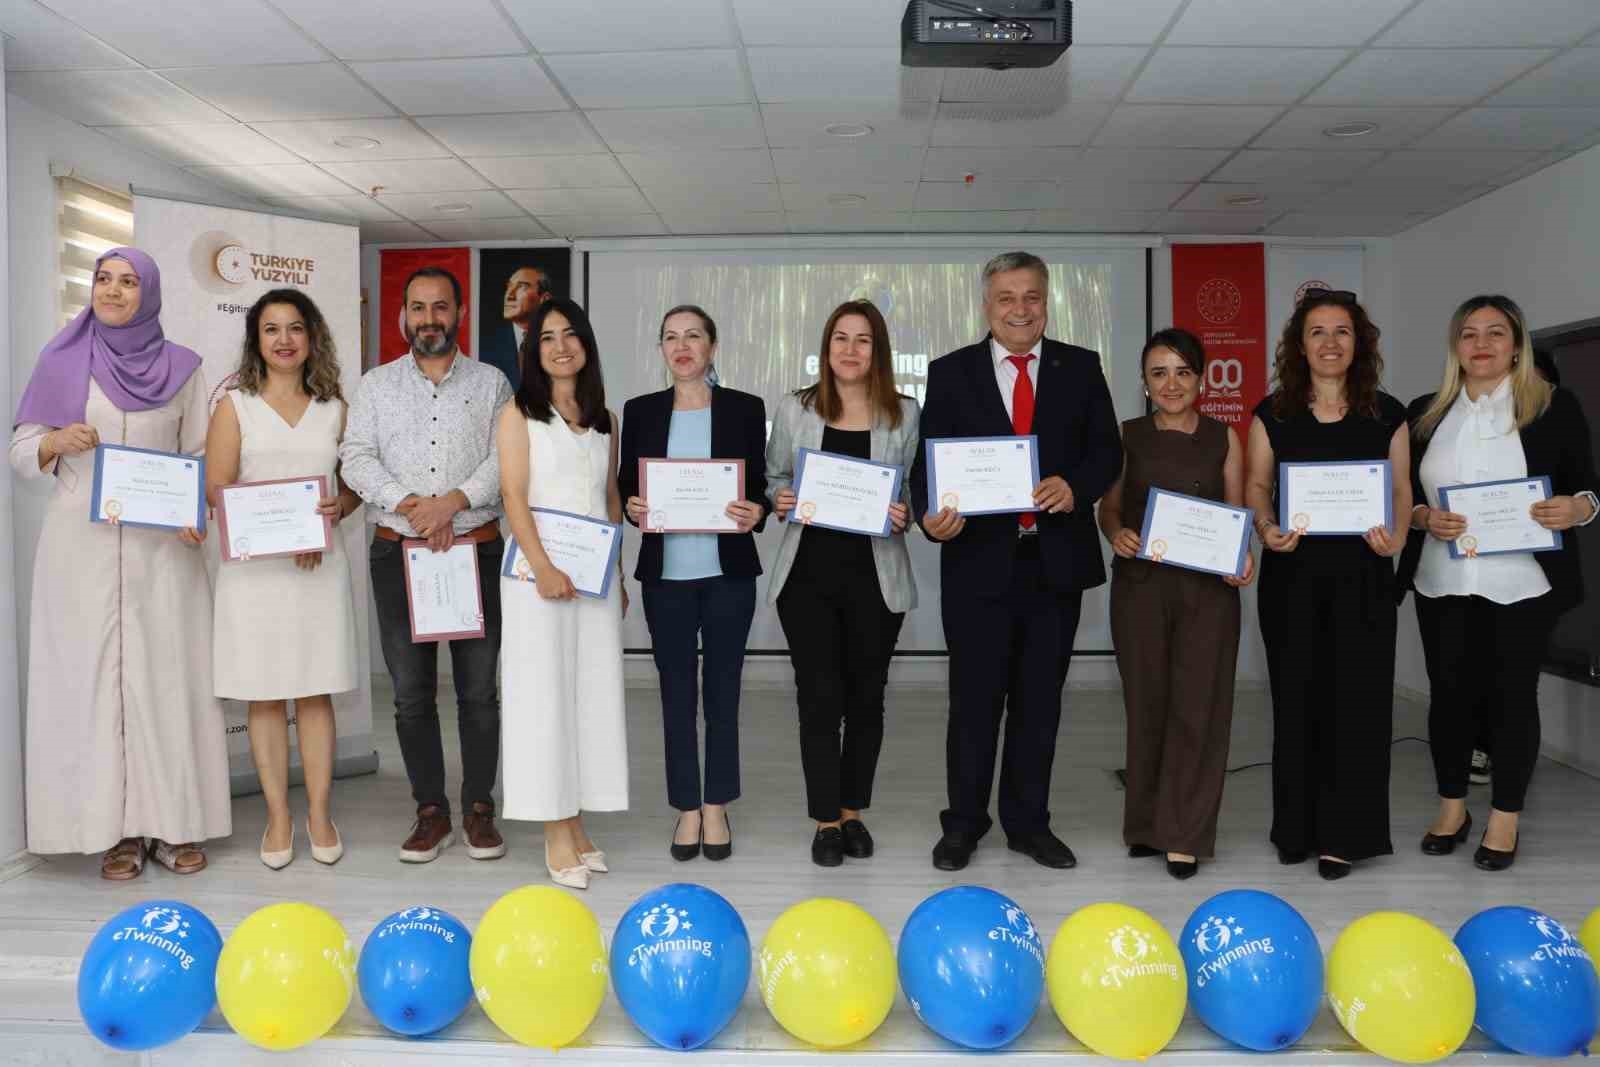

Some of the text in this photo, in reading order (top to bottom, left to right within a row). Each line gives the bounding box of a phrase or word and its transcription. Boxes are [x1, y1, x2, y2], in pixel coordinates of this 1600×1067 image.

[377, 919, 455, 944] eTwinning
[113, 927, 195, 970] eTwinning
[628, 936, 713, 967] eTwinning
[1197, 937, 1275, 987] eTwinning
[1100, 961, 1179, 988] eTwinning
